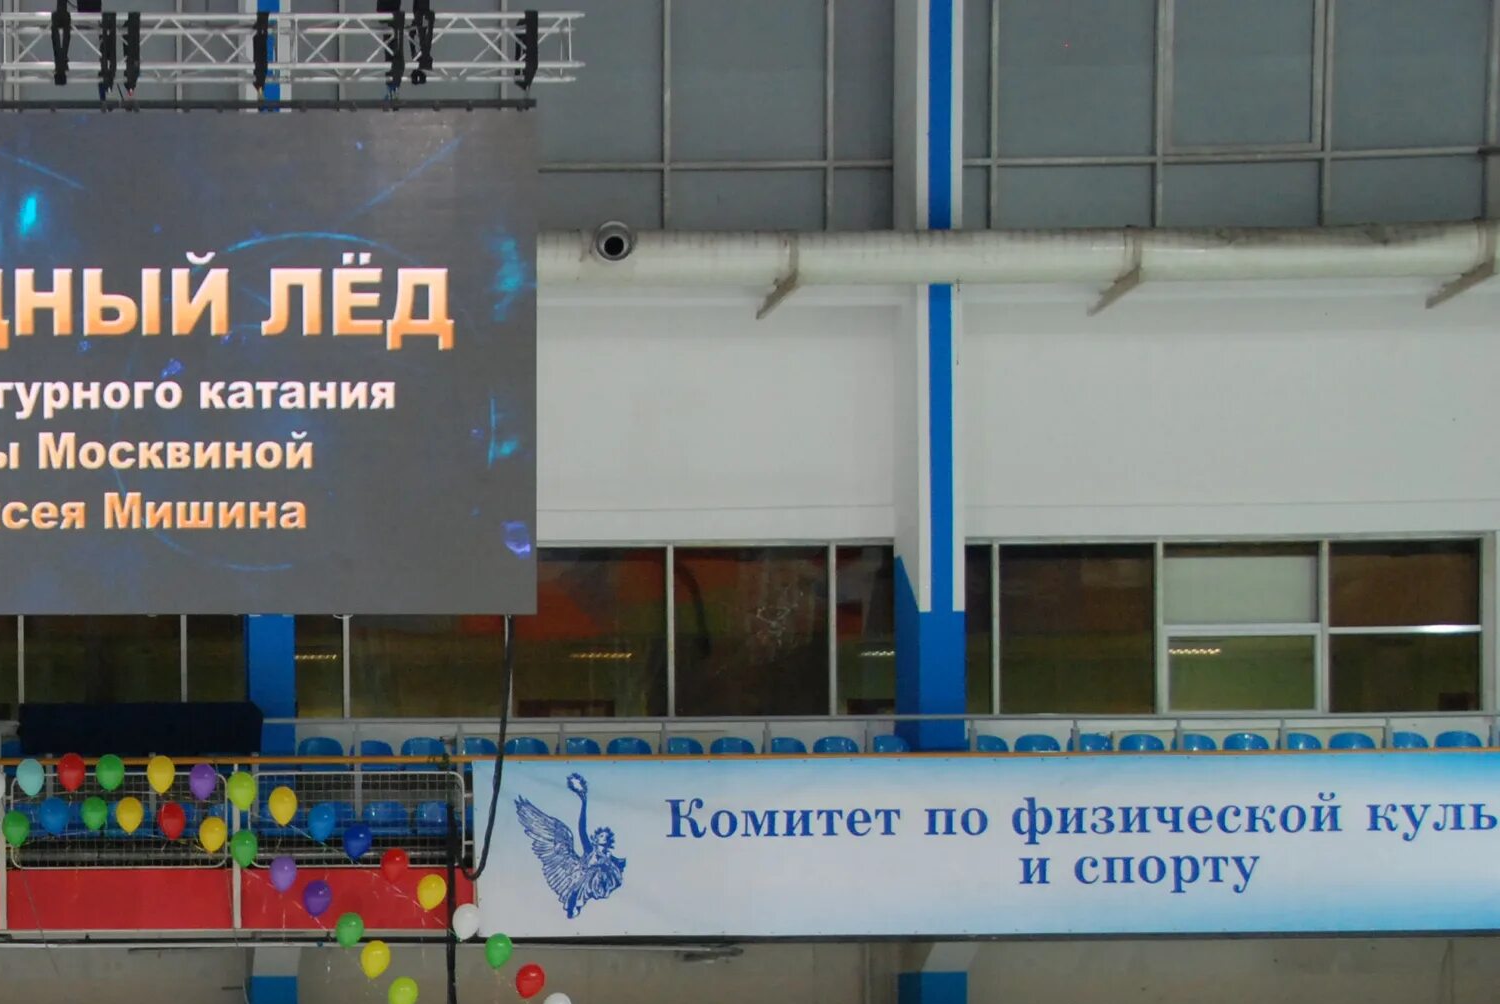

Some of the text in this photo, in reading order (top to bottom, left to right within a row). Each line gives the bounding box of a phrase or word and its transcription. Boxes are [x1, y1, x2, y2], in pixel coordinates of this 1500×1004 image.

[261, 252, 454, 351] ЛЁД
[199, 380, 395, 410] катания
[38, 431, 313, 470] Москвиной
[104, 492, 307, 530] Мишина
[665, 791, 1499, 845] Комитет по физической куль
[1018, 855, 1260, 893] и спорту
